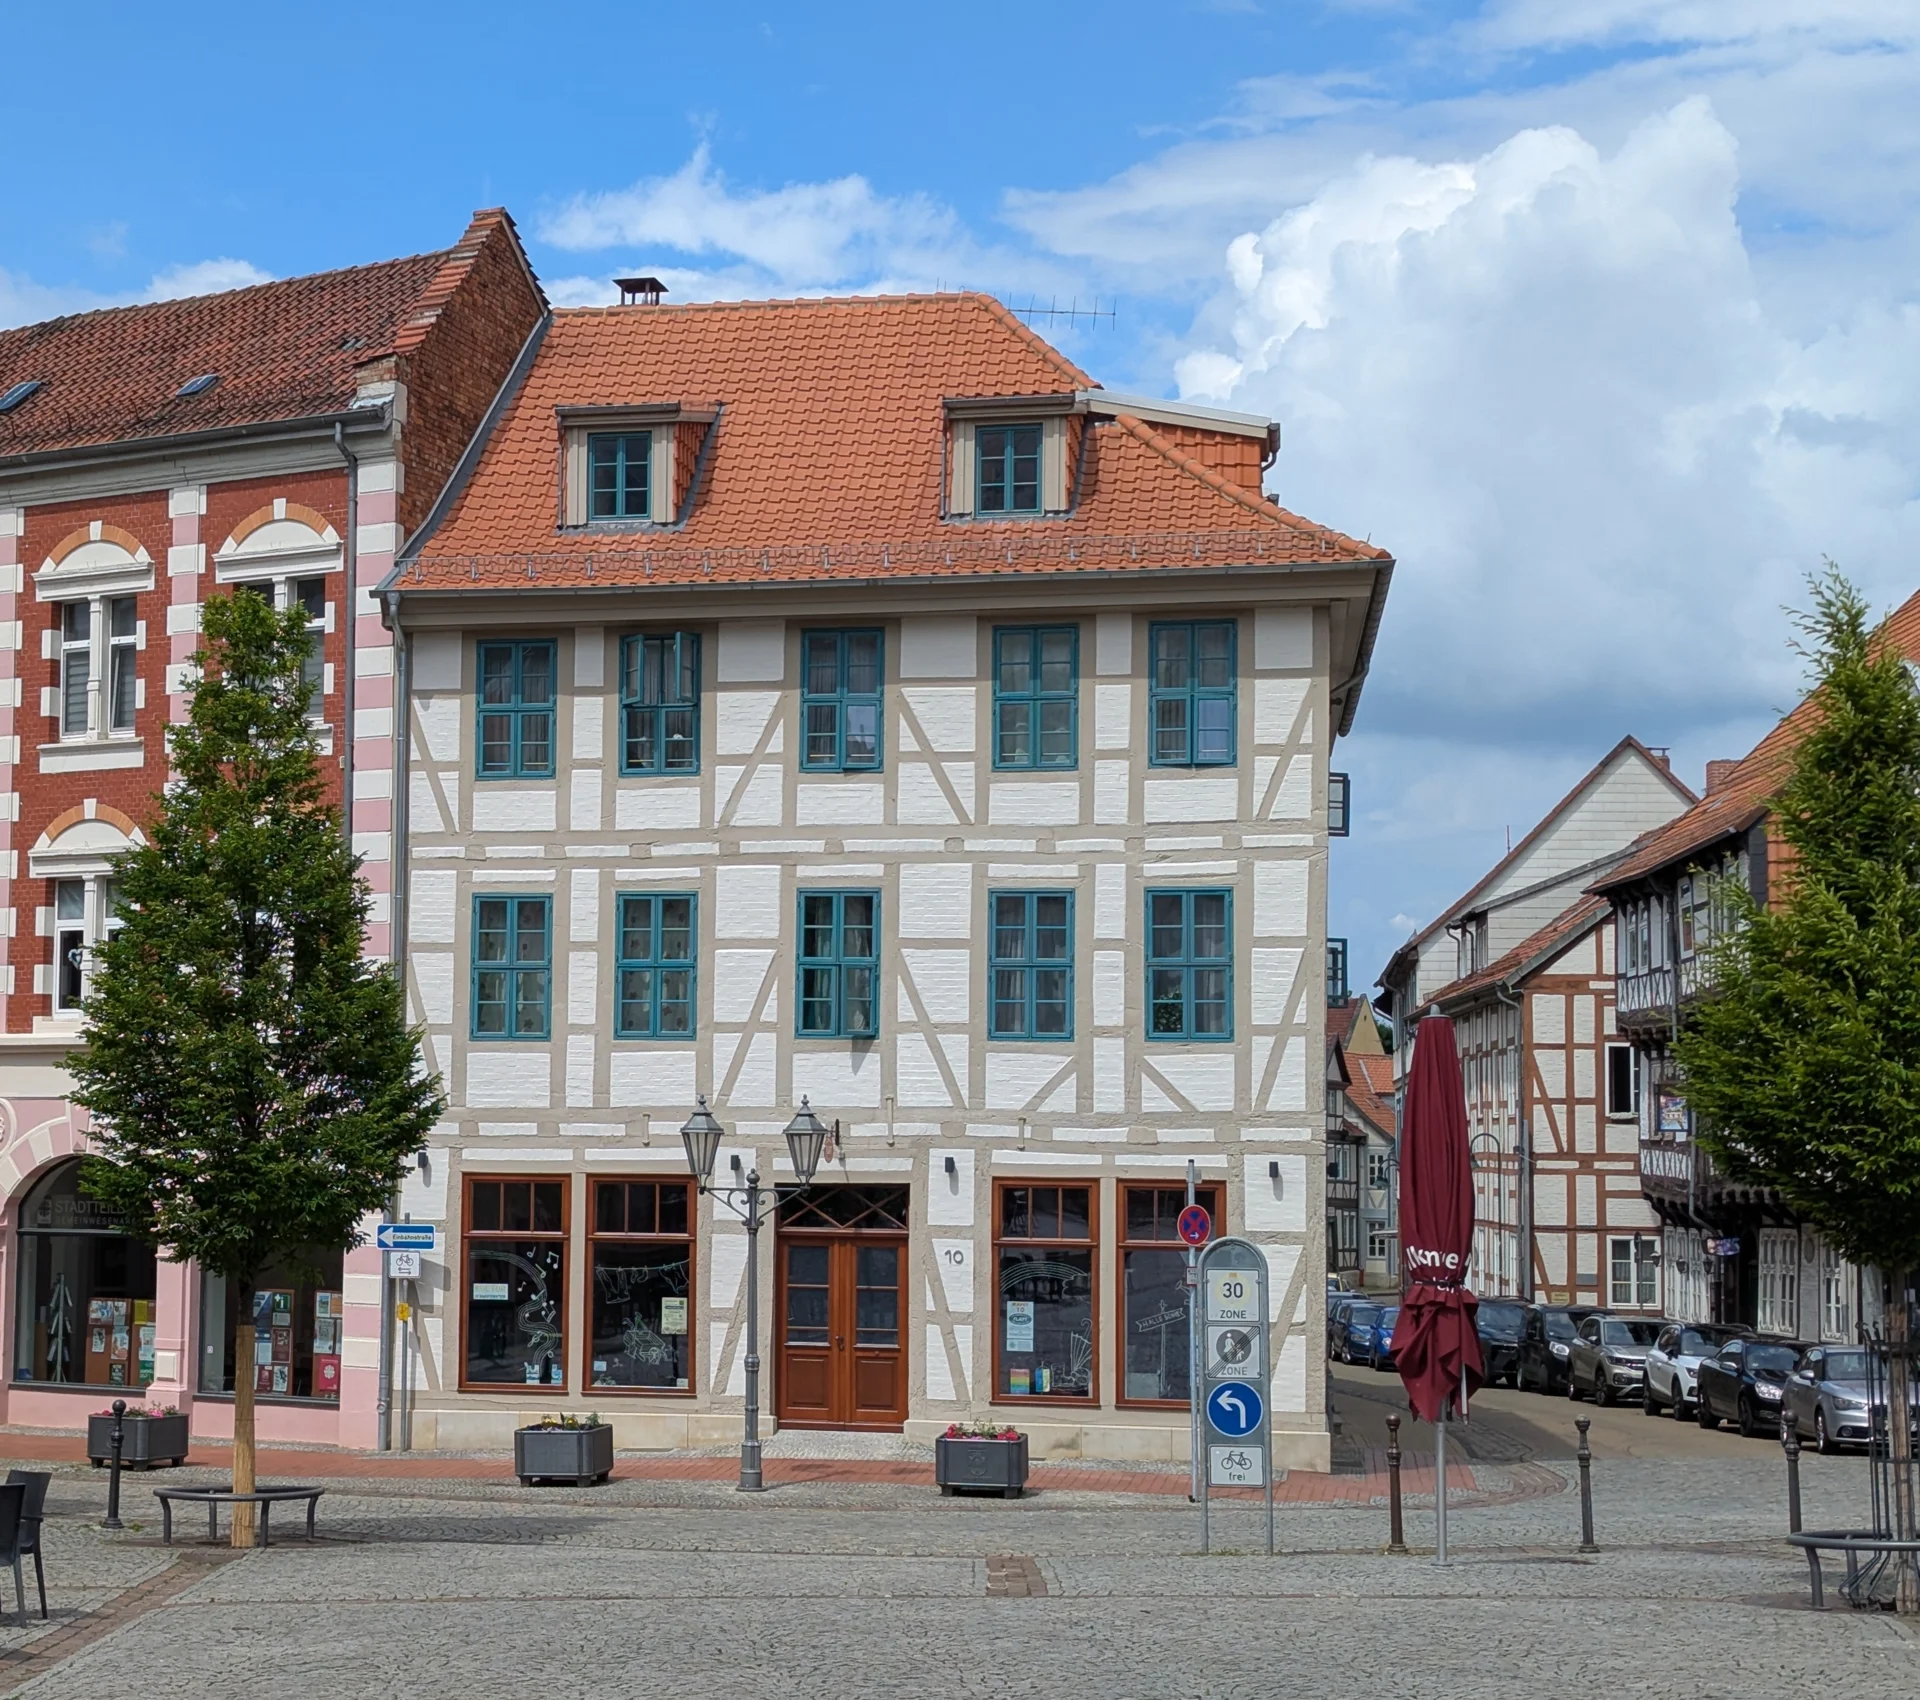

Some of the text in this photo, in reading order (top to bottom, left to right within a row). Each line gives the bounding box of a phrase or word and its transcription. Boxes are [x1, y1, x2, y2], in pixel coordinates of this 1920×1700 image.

[392, 1233, 432, 1241] Einbahnstraße
[944, 1249, 964, 1265] 10
[1222, 1282, 1244, 1299] 30
[1219, 1309, 1247, 1319] ZONE
[1220, 1366, 1248, 1376] ZONE
[1228, 1471, 1246, 1481] frei
